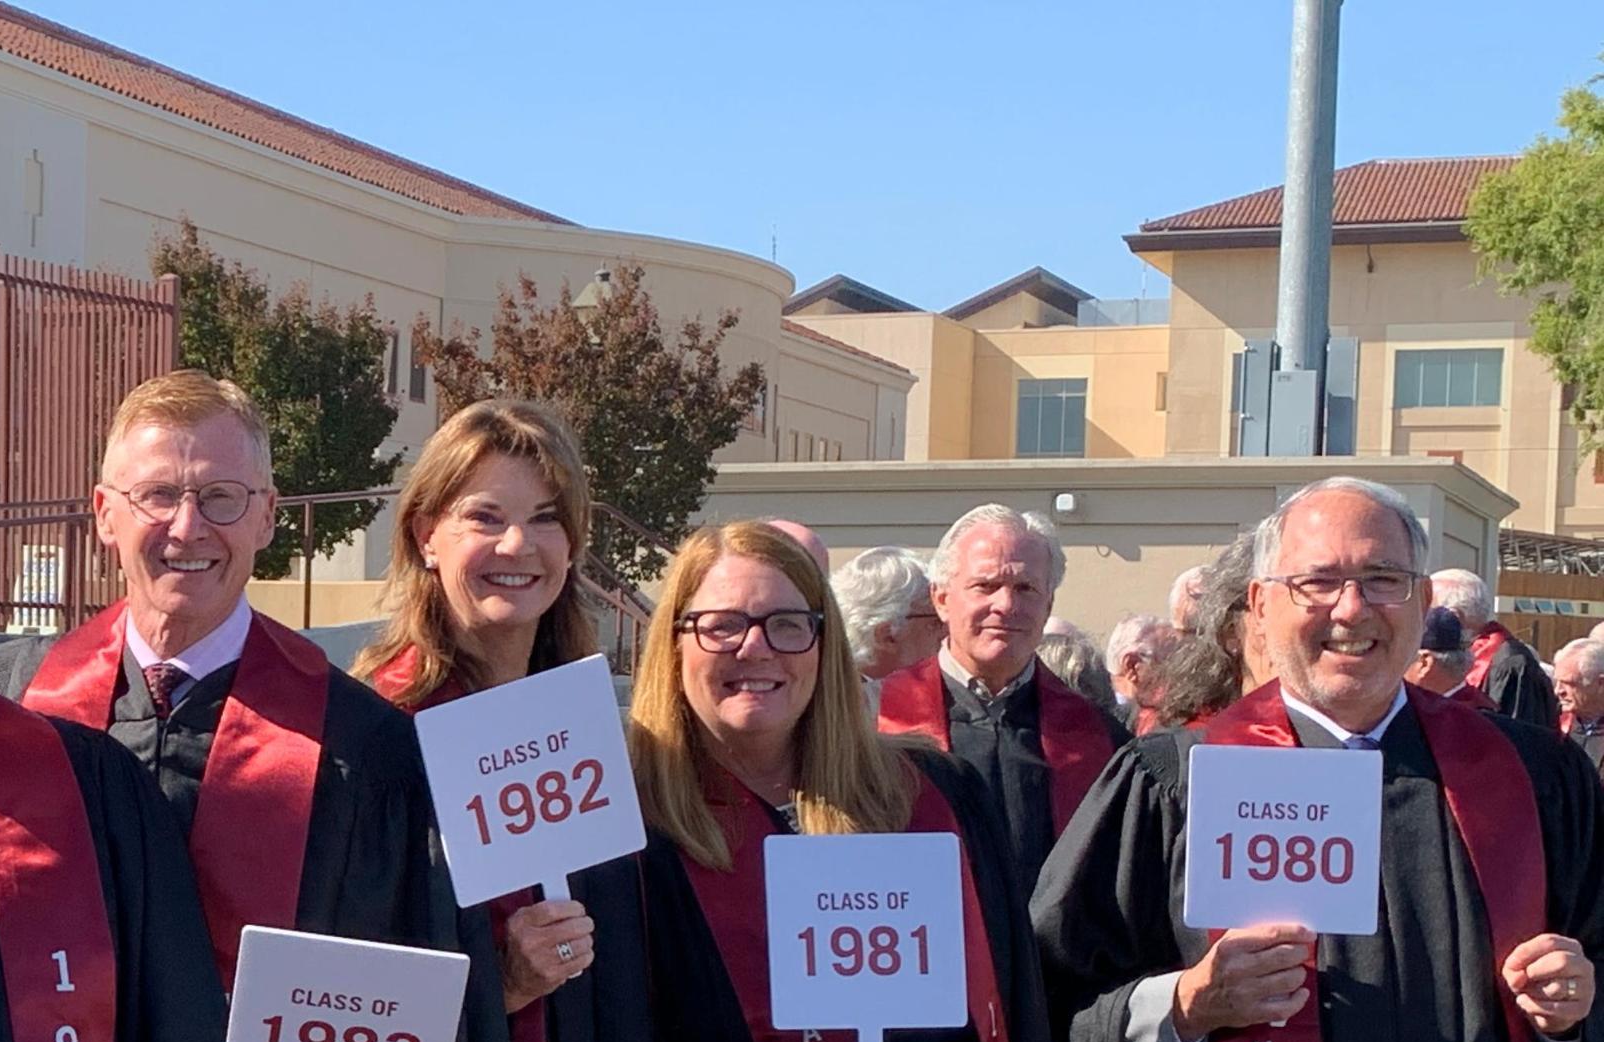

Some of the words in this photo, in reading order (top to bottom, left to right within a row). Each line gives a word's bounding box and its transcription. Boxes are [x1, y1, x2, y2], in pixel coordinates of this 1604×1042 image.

[477, 740, 542, 776] CLASS
[546, 729, 569, 753] OF
[465, 758, 610, 846] 1982
[1237, 801, 1299, 821] CLASS
[1306, 803, 1330, 822] OF
[1215, 832, 1354, 885] 1980
[817, 891, 879, 912] CLASS
[886, 891, 910, 910] OF
[797, 924, 929, 977] 1981
[291, 987, 363, 1013] CLASS
[371, 999, 400, 1017] OF
